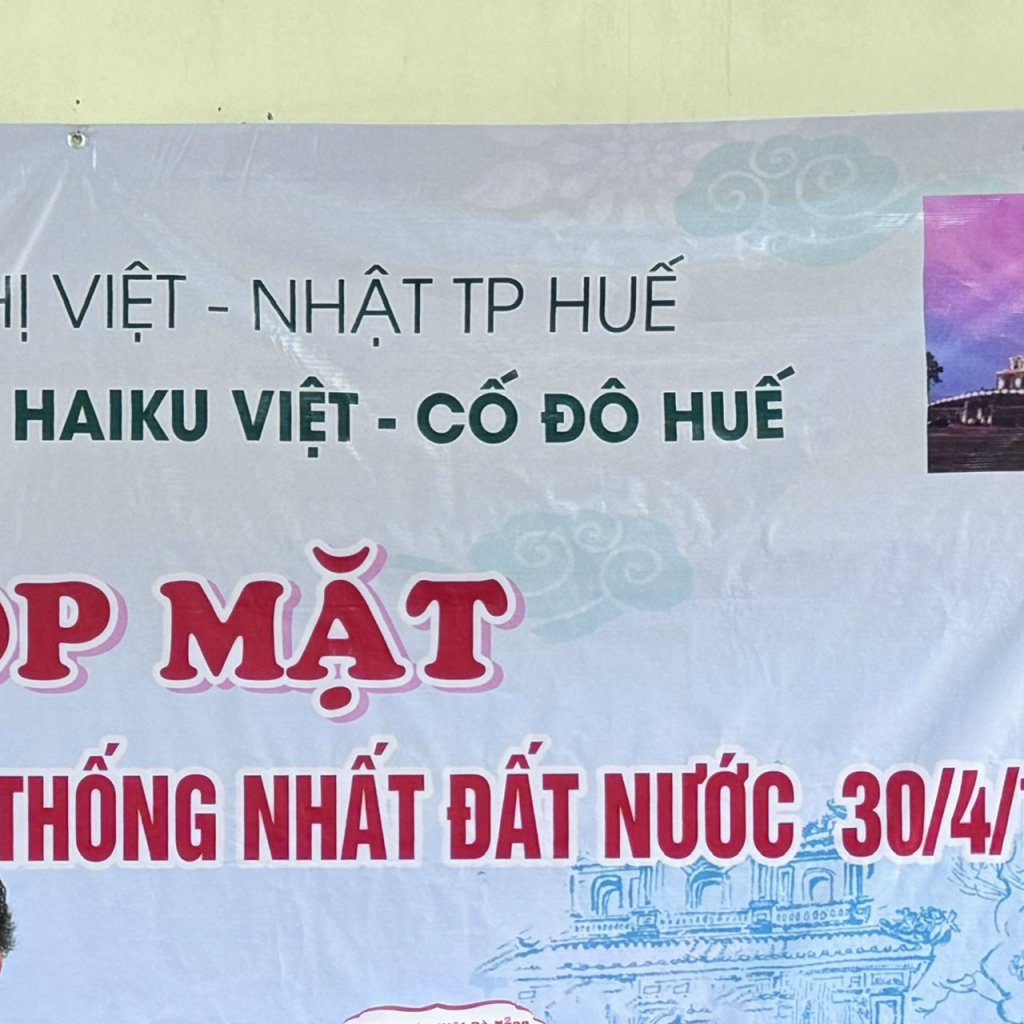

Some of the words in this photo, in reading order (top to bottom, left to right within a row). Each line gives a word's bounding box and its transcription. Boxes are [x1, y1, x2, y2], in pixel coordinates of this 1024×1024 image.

[53, 261, 186, 342] VIỆT
[253, 263, 432, 347] NHẬT
[453, 277, 524, 333] TP
[549, 254, 685, 332] HUẾ
[15, 389, 207, 442] HAIKU
[232, 377, 358, 458] VIỆT
[378, 418, 396, 429] -
[417, 369, 518, 445] CỐ
[541, 378, 639, 443] ĐÔ
[664, 366, 795, 441] HUẾ
[157, 545, 509, 712] MẶT
[243, 741, 425, 860] NHẤT
[446, 741, 580, 860] ĐẤT
[603, 753, 795, 860] NƯỚC
[840, 766, 1024, 857] 30/4/
